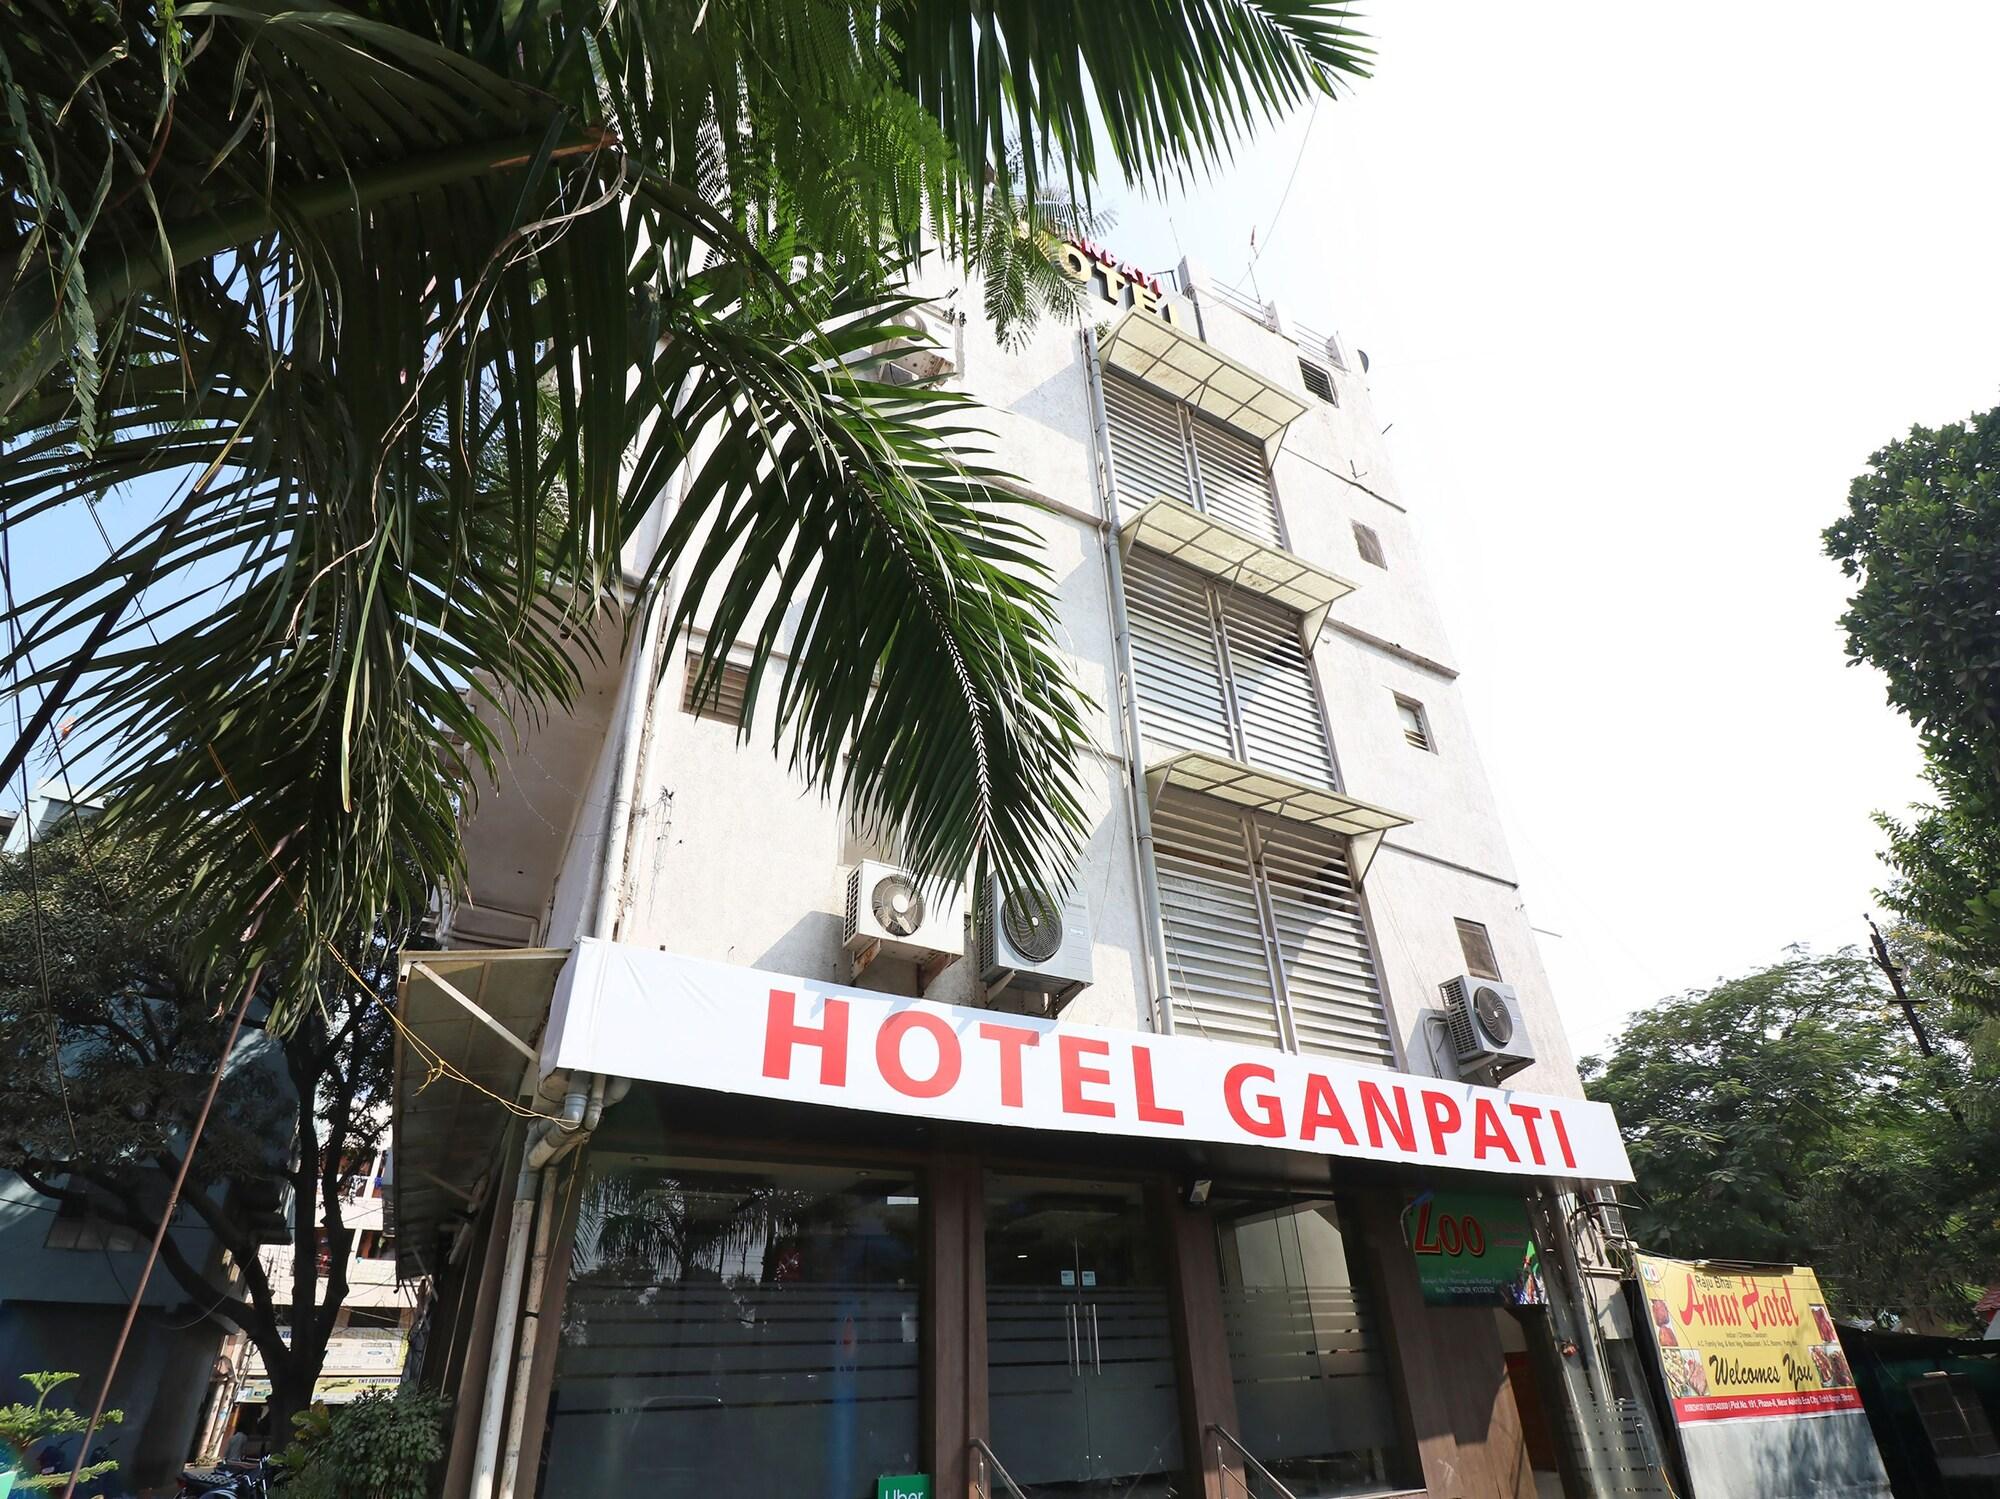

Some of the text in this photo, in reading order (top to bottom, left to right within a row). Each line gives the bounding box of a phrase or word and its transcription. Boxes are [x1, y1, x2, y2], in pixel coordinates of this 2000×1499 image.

[762, 988, 1578, 1169] HOTEL GANPATI
[1680, 1273, 1799, 1331] Amar Hotel
[1695, 1275, 1713, 1291] Raju
[1709, 1353, 1813, 1391] Welcomes You
